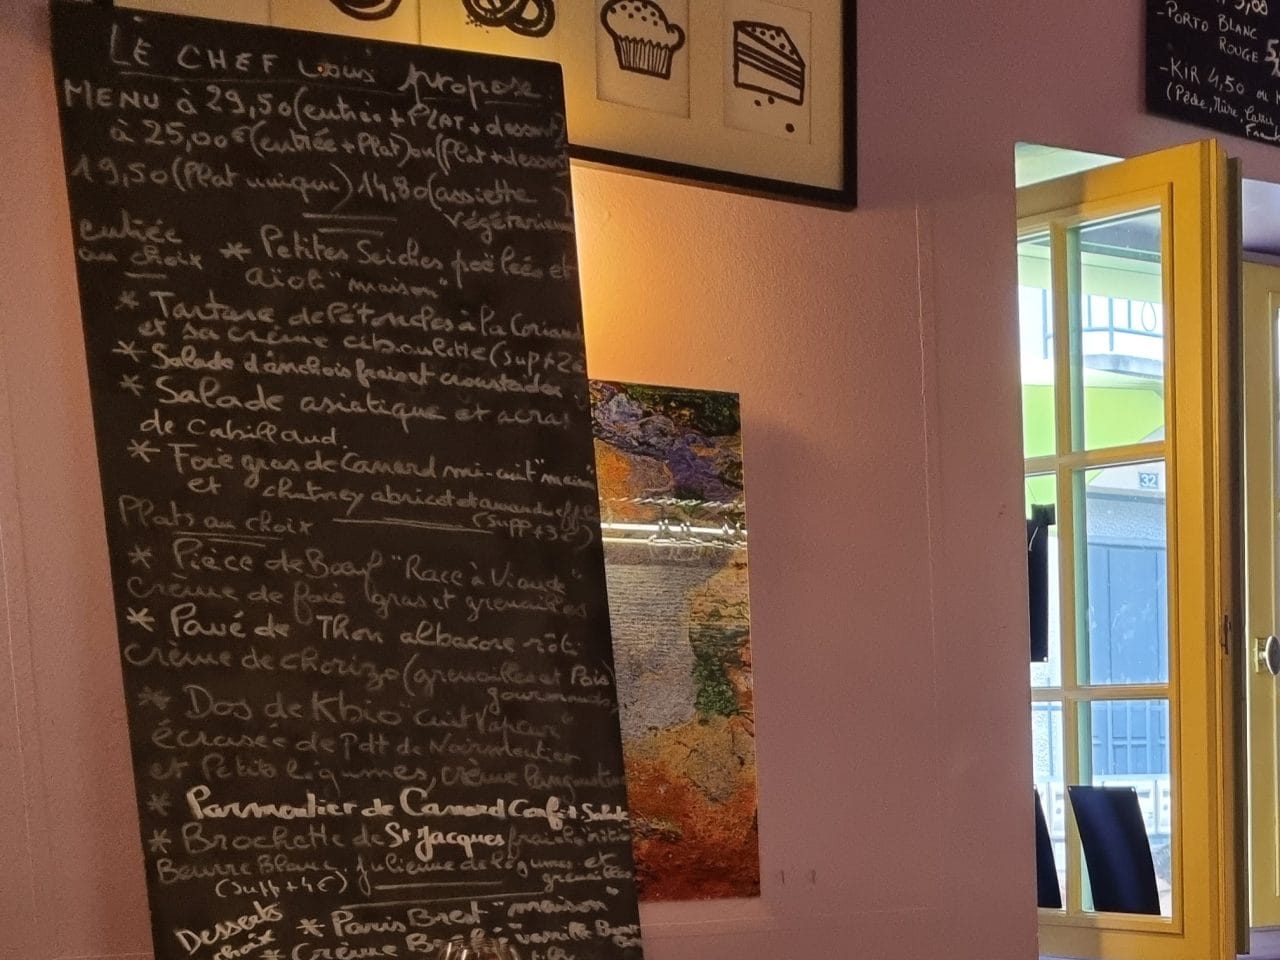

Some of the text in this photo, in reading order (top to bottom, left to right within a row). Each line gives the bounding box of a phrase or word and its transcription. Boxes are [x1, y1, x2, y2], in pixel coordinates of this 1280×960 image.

[1217, 13, 1259, 40] BLANC
[176, 43, 279, 75] CHEF
[1218, 35, 1259, 64] ROUGE
[1207, 67, 1245, 95] 4,50
[63, 77, 161, 110] MENU
[176, 88, 199, 115] à
[109, 118, 135, 143] à
[71, 153, 168, 189] 19,50
[154, 375, 285, 412] Salade
[139, 407, 176, 437] de
[186, 475, 222, 496] et
[1140, 473, 1157, 487] 32
[170, 601, 247, 638] Pavé
[253, 612, 291, 640] de
[264, 691, 305, 719] de
[360, 797, 396, 819] de
[181, 821, 346, 855] Brochette
[414, 825, 506, 863] Jacques
[330, 900, 489, 938] Paris Brest
